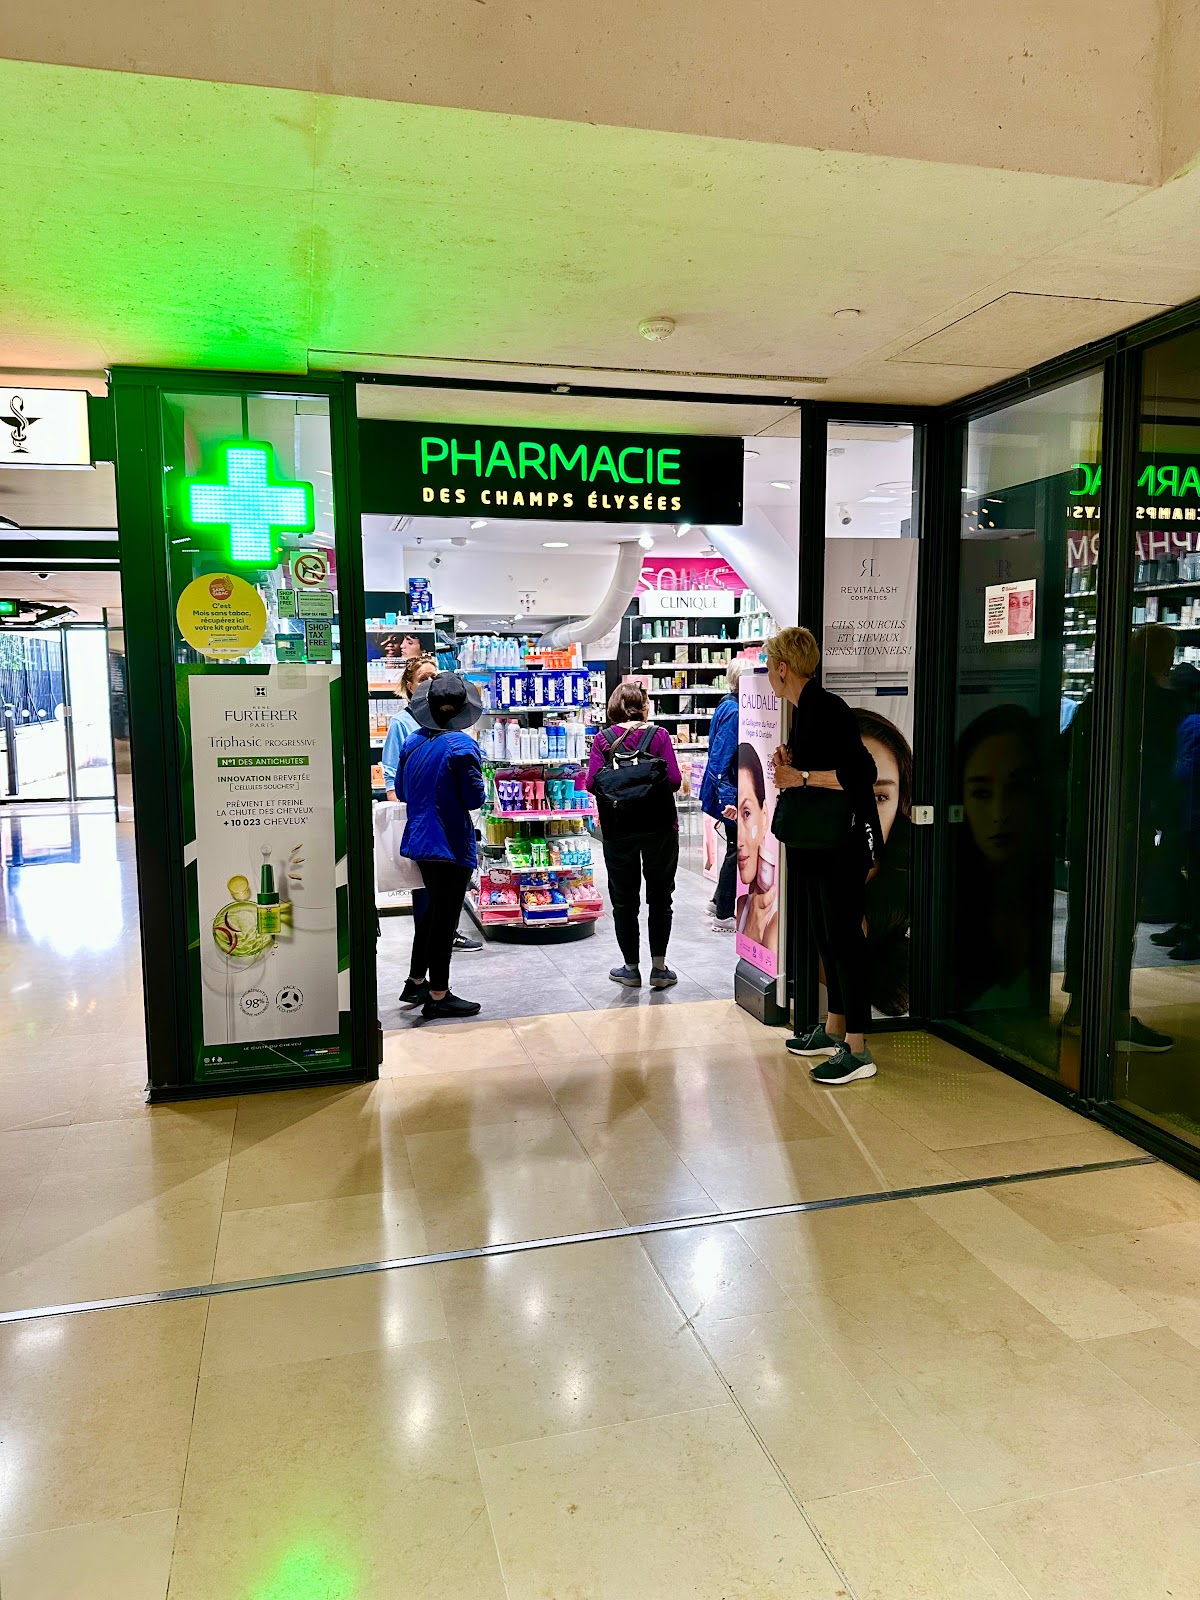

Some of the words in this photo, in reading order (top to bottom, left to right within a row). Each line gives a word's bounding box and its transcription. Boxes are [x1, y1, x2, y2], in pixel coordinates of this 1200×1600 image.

[421, 437, 681, 485] PHARMACIE
[422, 487, 466, 504] DES
[480, 489, 573, 508] CHAMPS
[588, 491, 682, 511] ÉLYSÉES
[638, 567, 729, 591] SOINS
[840, 586, 899, 594] REVITALASH
[660, 596, 719, 610] CLINIQUE
[229, 610, 252, 618] tabac,
[201, 616, 236, 625] récupérez
[237, 616, 245, 624] ici
[857, 619, 907, 630] SOURCILS
[225, 624, 252, 632] gratuit.
[308, 623, 329, 631] SHOP
[309, 631, 324, 639] TAX
[837, 633, 851, 643] ET
[851, 633, 901, 643] CHEVEUX
[225, 710, 298, 722] FURTERER
[208, 735, 263, 750] Triphasic
[264, 739, 317, 747] PROGRESSIVE
[238, 758, 253, 766] DES
[217, 775, 271, 783] INNOVATION
[273, 773, 310, 782] BREVETÉE
[226, 799, 263, 808] PRÉVIENT
[277, 799, 304, 807] FREINE
[216, 809, 226, 817] LA
[229, 808, 257, 816] CHUTE
[276, 807, 314, 815] CHEVEUX
